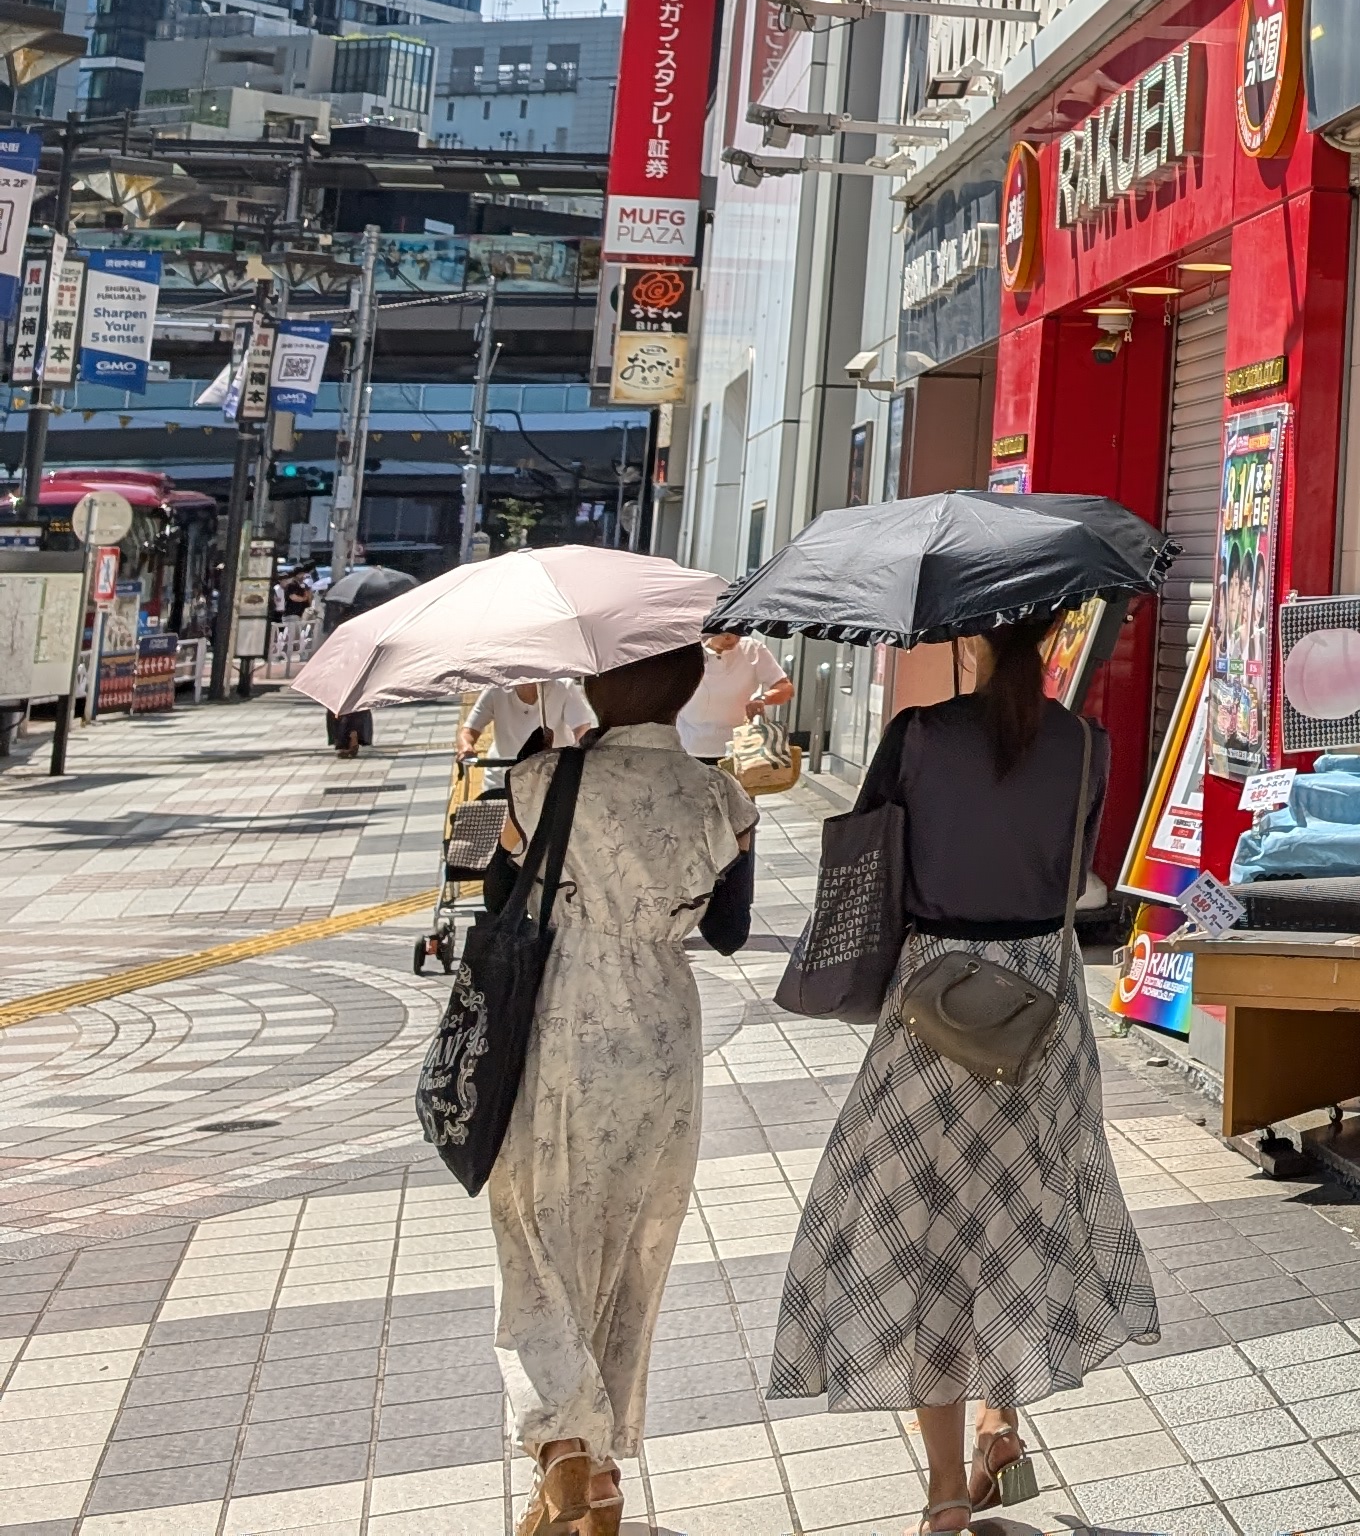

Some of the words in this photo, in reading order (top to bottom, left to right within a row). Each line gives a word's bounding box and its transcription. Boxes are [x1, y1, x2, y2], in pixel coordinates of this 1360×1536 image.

[1055, 41, 1190, 230] RAKUEN
[618, 206, 687, 228] MUFG
[616, 224, 686, 246] PLAZA
[93, 307, 147, 320] Sharpen
[104, 320, 136, 332] Your
[90, 331, 100, 343] 5
[102, 332, 145, 344] senses
[95, 360, 137, 373] GMO
[1191, 893, 1212, 913] 680
[1203, 890, 1235, 922] カットスイカ
